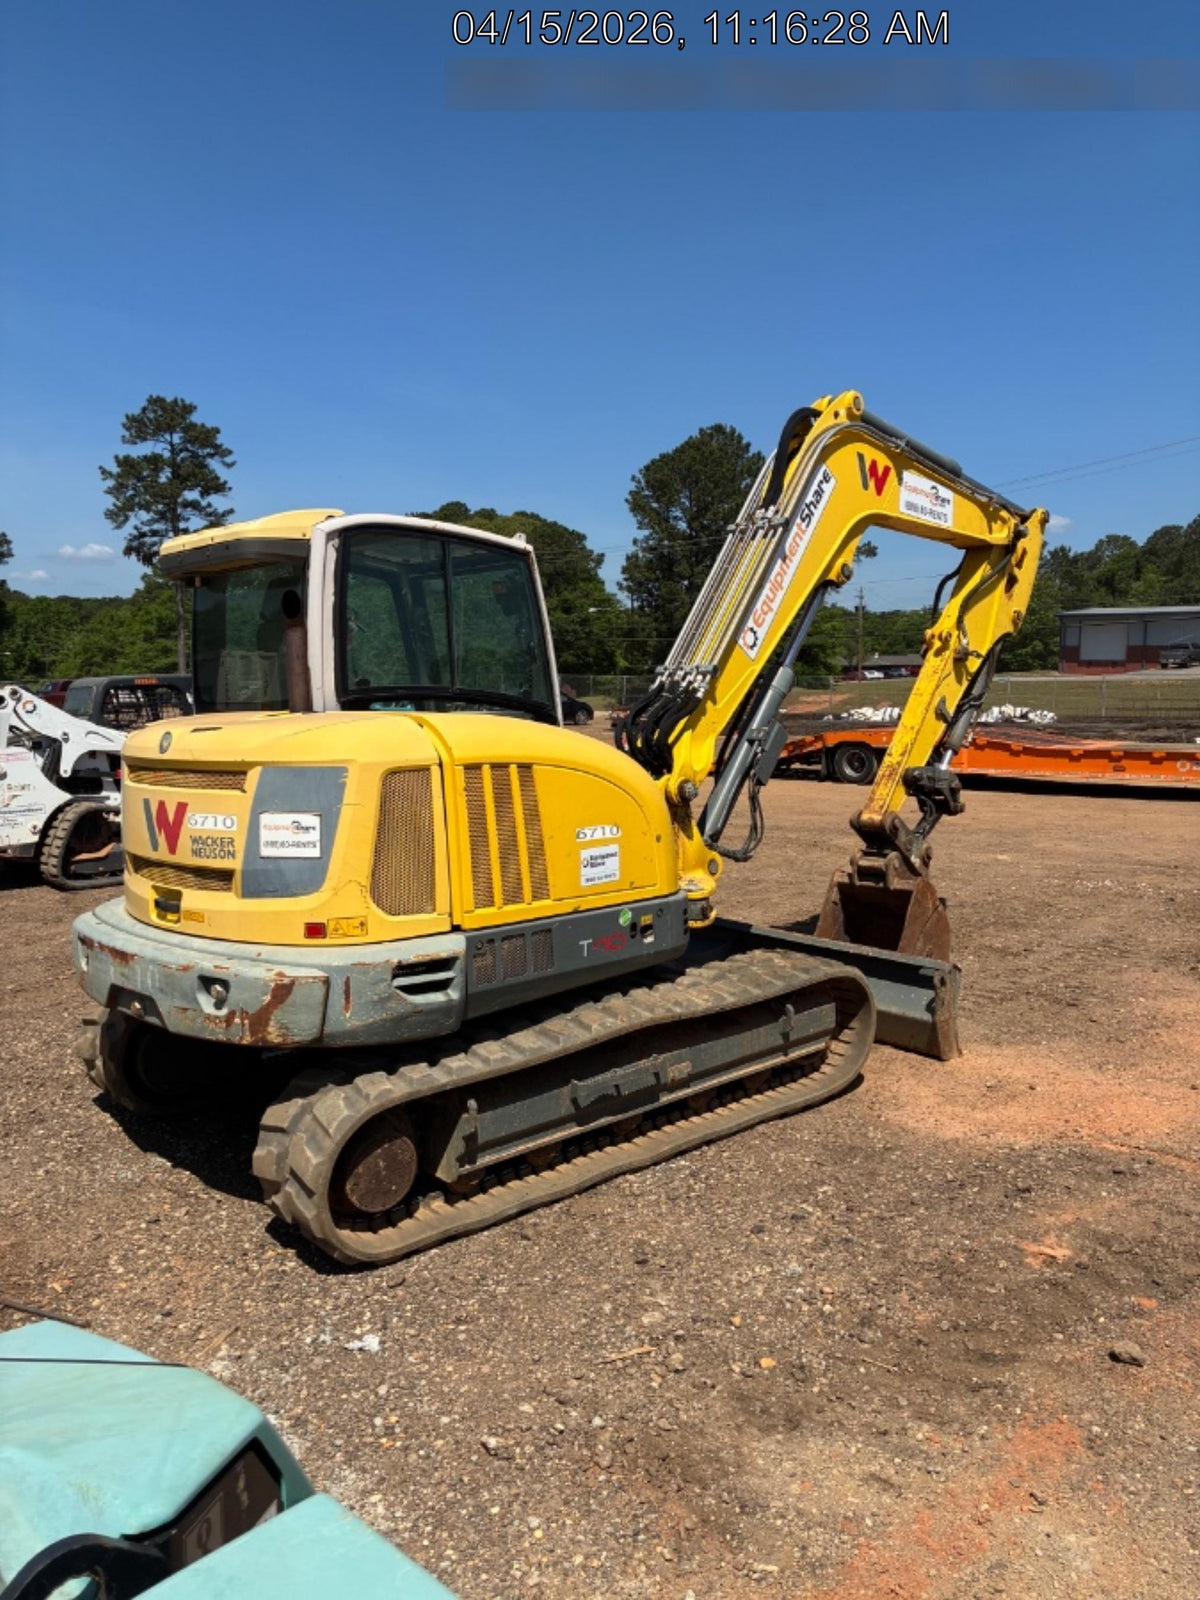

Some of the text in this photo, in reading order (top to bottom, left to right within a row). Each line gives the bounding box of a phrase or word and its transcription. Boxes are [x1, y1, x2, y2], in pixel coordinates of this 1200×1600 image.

[188, 814, 236, 829] 6710
[576, 824, 620, 840] 6710
[189, 835, 236, 849] WACKER
[191, 847, 236, 860] NEUSON
